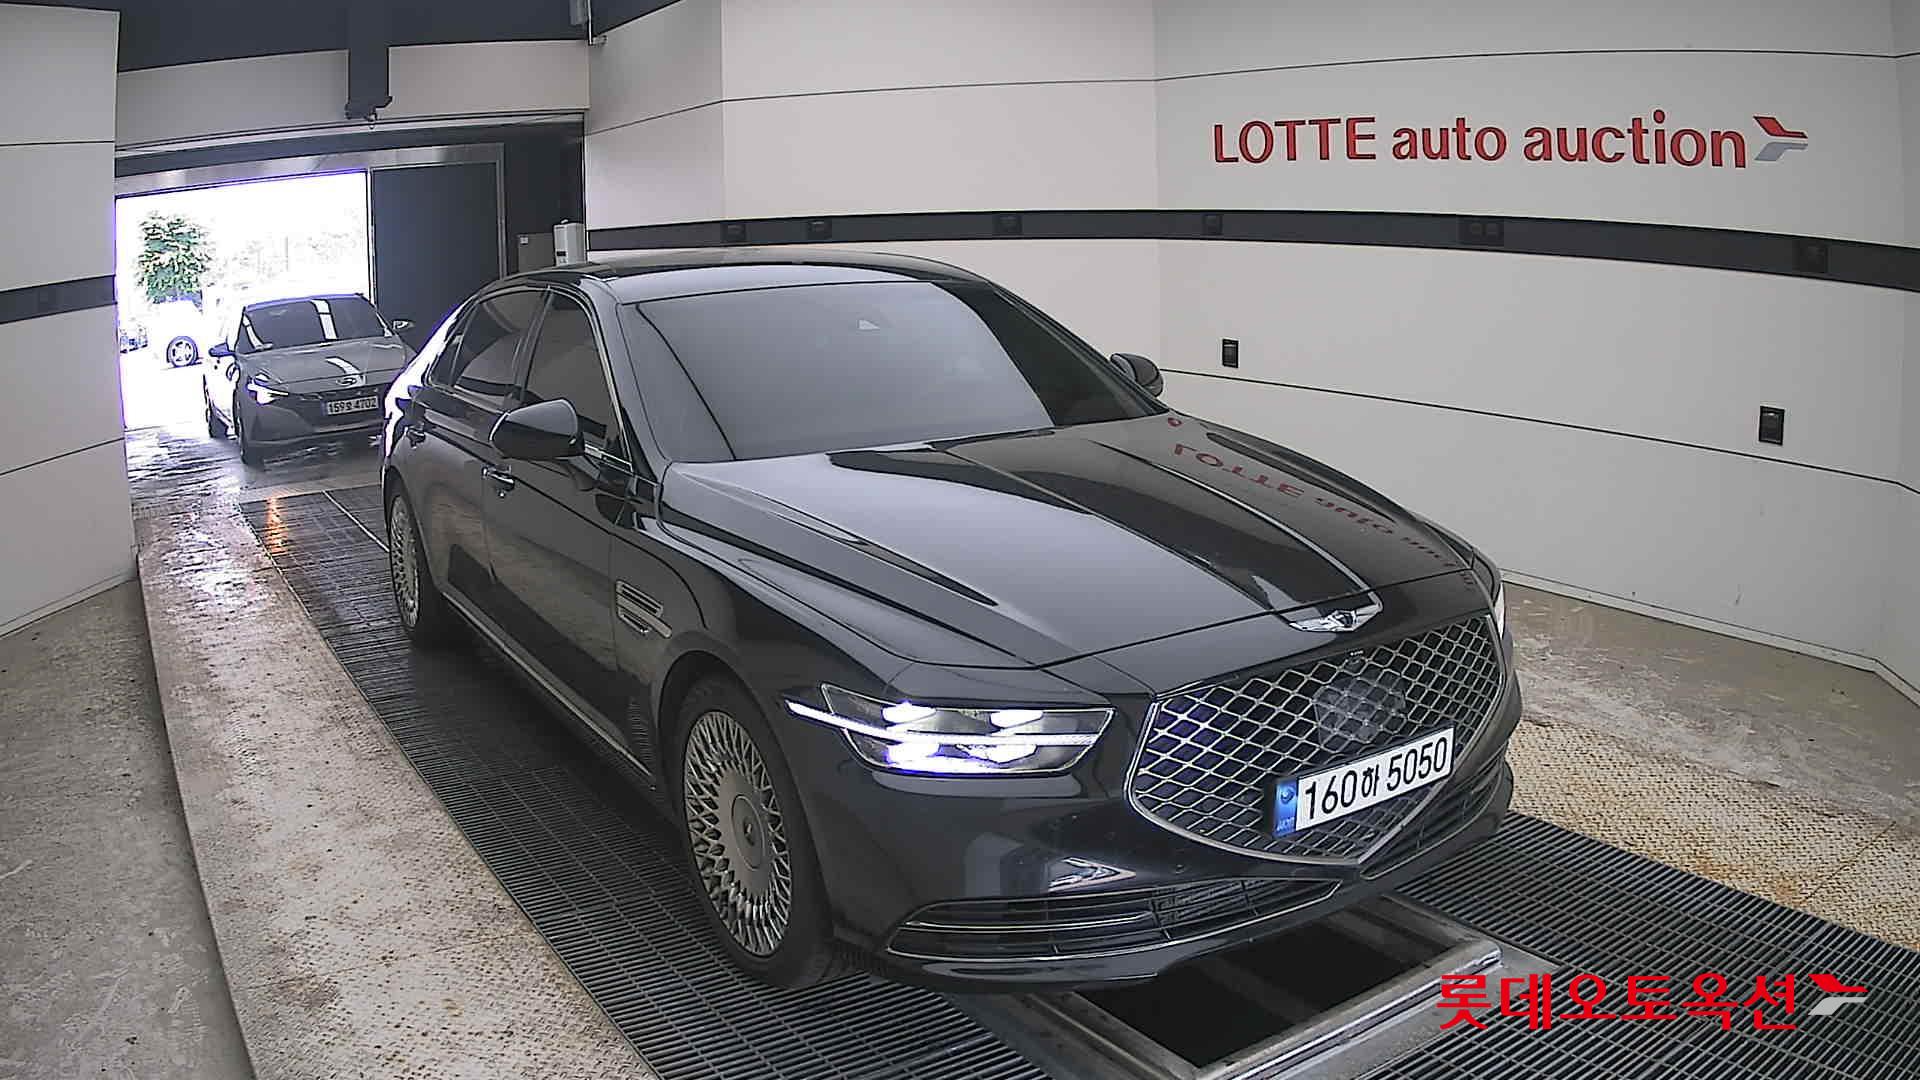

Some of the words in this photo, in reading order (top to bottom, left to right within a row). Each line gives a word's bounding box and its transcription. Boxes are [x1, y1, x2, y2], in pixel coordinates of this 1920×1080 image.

[1213, 116, 1377, 163] LOTTE
[1391, 117, 1508, 162] auto
[1523, 109, 1748, 169] auction
[1304, 763, 1380, 820] 160하
[1387, 736, 1448, 792] 5050
